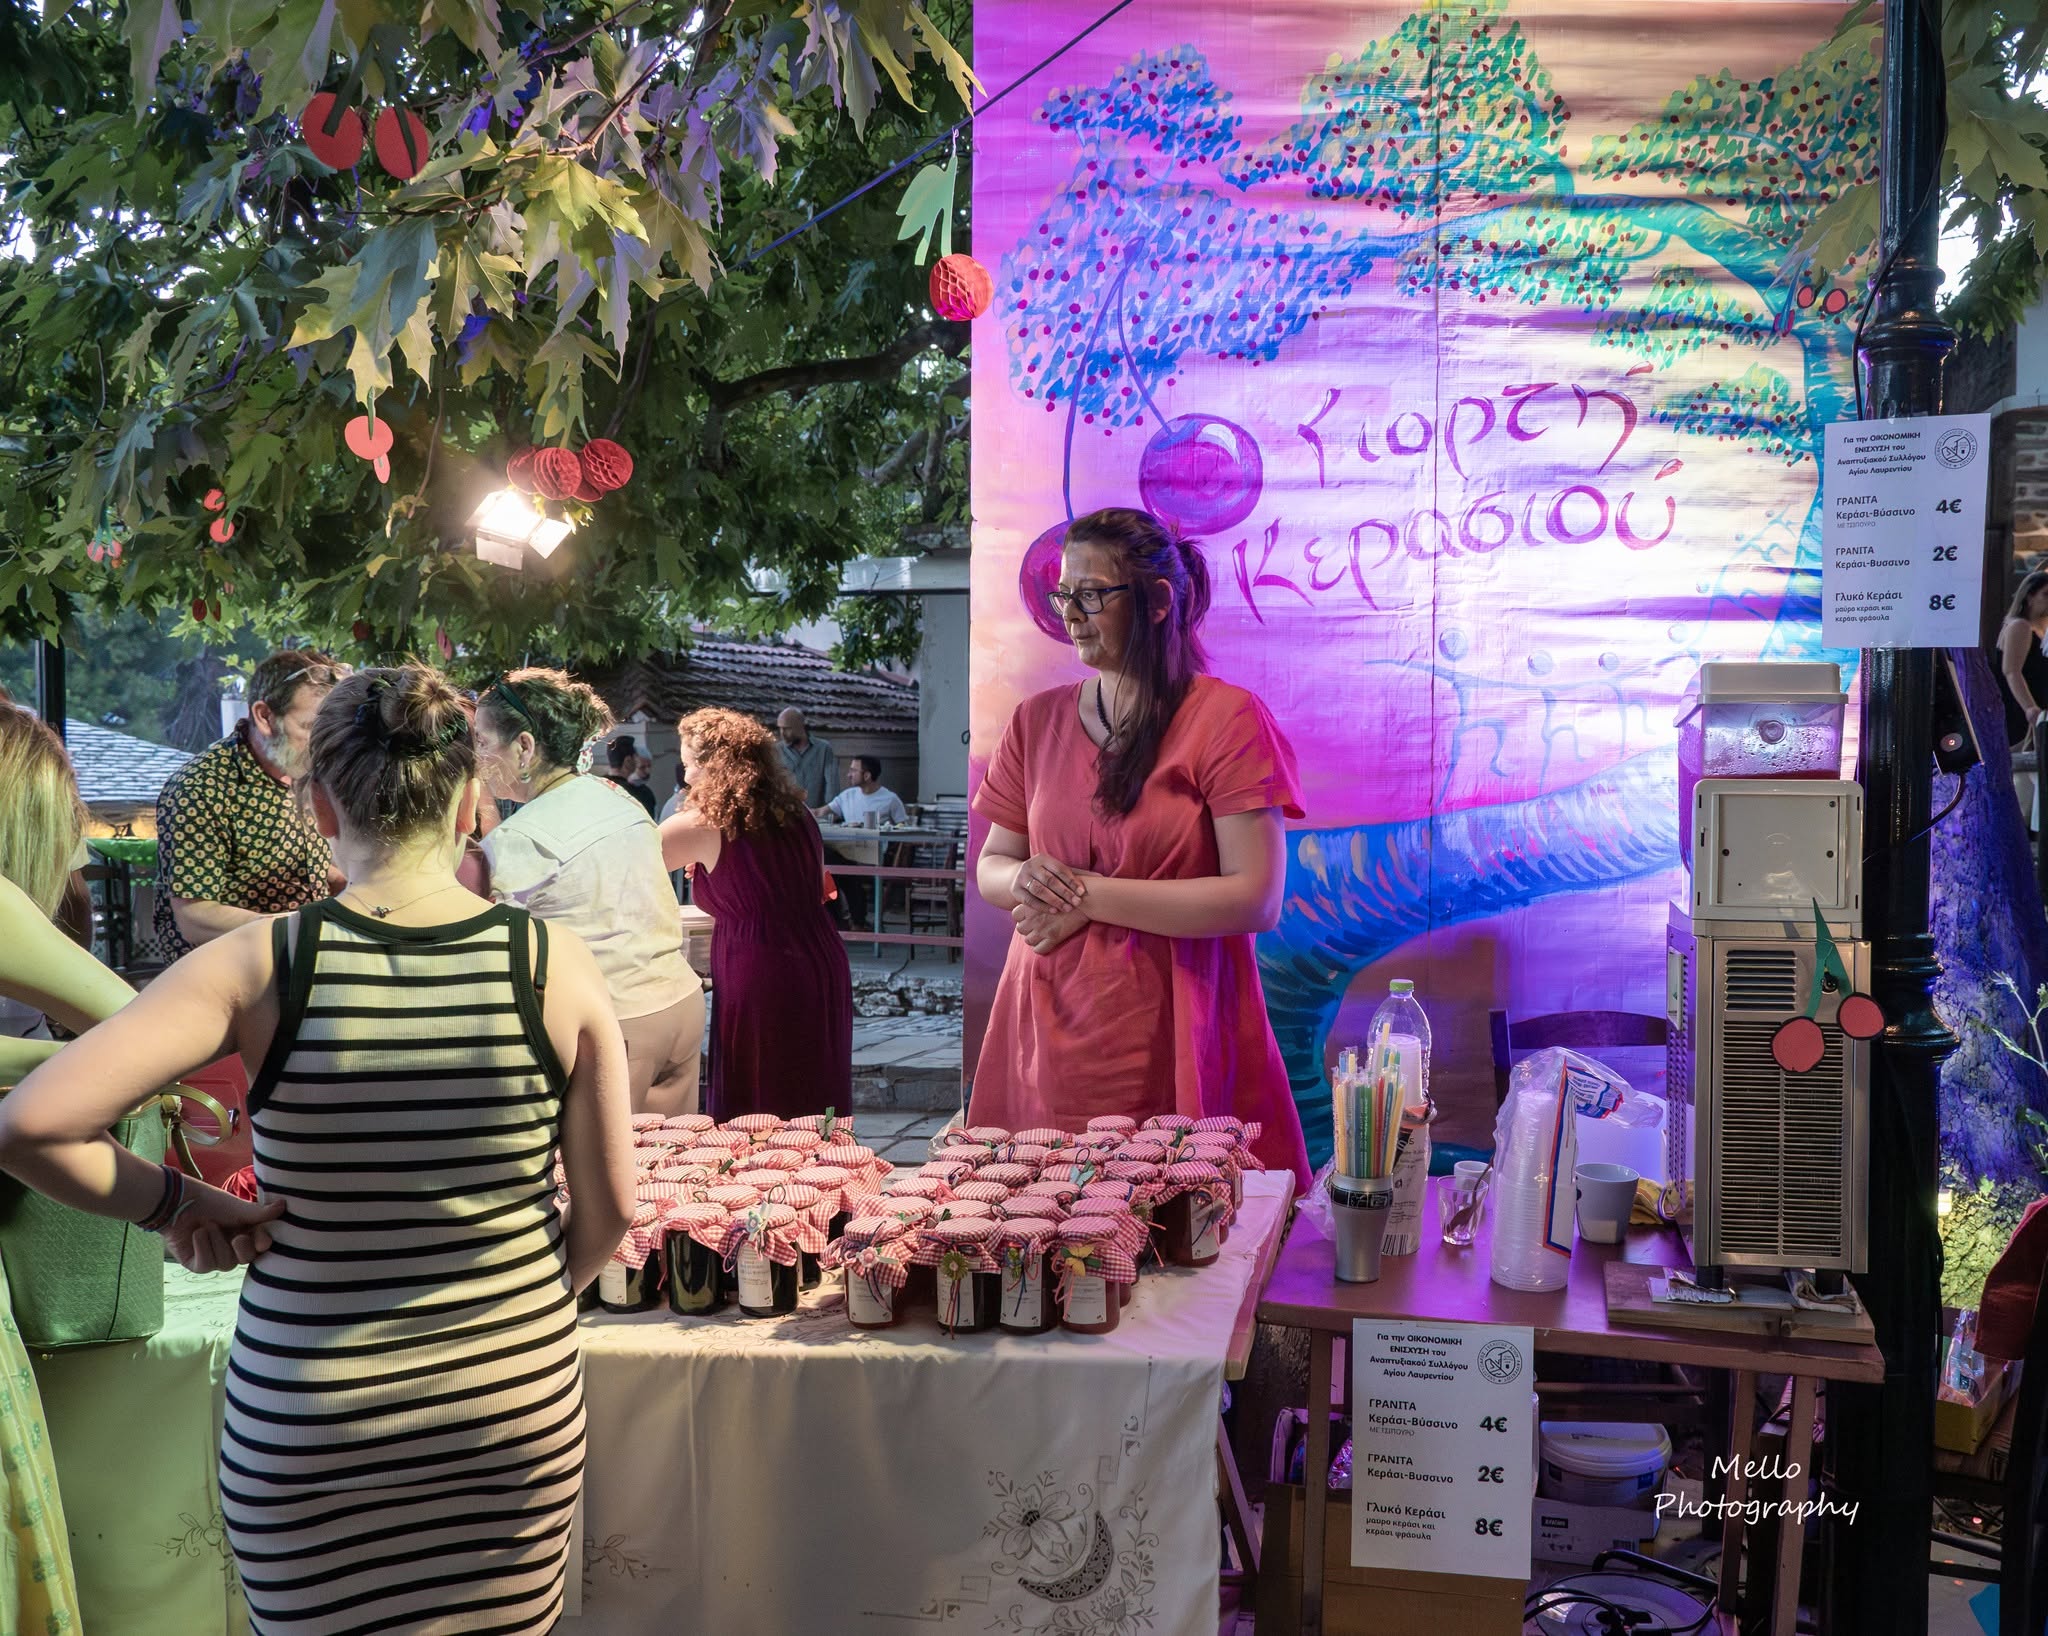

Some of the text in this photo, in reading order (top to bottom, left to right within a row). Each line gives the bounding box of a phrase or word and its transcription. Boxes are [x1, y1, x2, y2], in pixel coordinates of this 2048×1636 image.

[1844, 432, 1921, 444] Για την ΟΙΚΟΝΟΜΙΚΗ
[1854, 444, 1906, 454] ΕΝΙΣΧΥΣΗ του
[1837, 455, 1888, 466] Αναπτυξιακού
[1889, 453, 1926, 464] Συλλόγου
[1848, 465, 1913, 477] Αγίου Λαυρεντίου
[1836, 495, 1878, 506] ΓΡΑΝΙΤΑ
[1836, 498, 1962, 521] Κεράσι-Βύσσινο 4€
[1231, 458, 1684, 627] Κερασιού
[1836, 545, 1958, 562] ΓΡΑΝΙΤΑ 2€
[1836, 590, 1956, 611] Γλυκό Κεράσι 8€
[1377, 1333, 1462, 1346] Για την ΟΙΚΟΝΟΜΙΚΗ
[1390, 1345, 1430, 1355] ΕΝΙΣΧΥΣΗ
[1370, 1356, 1426, 1368] Αναπτυξιακού
[1428, 1360, 1468, 1372] Συλλόγου
[1383, 1368, 1454, 1382] Αγίου Λαυρεντίου
[1369, 1398, 1417, 1412] ΓΡΑΝΙΤΑ
[1368, 1413, 1508, 1433] Κεράσι-Βύσσινο 4€
[1367, 1453, 1505, 1484] ΓΡΑΝΙΤΑ 2€
[1366, 1502, 1446, 1520] Γλυκό Κεράσι
[1474, 1517, 1504, 1537] 8€
